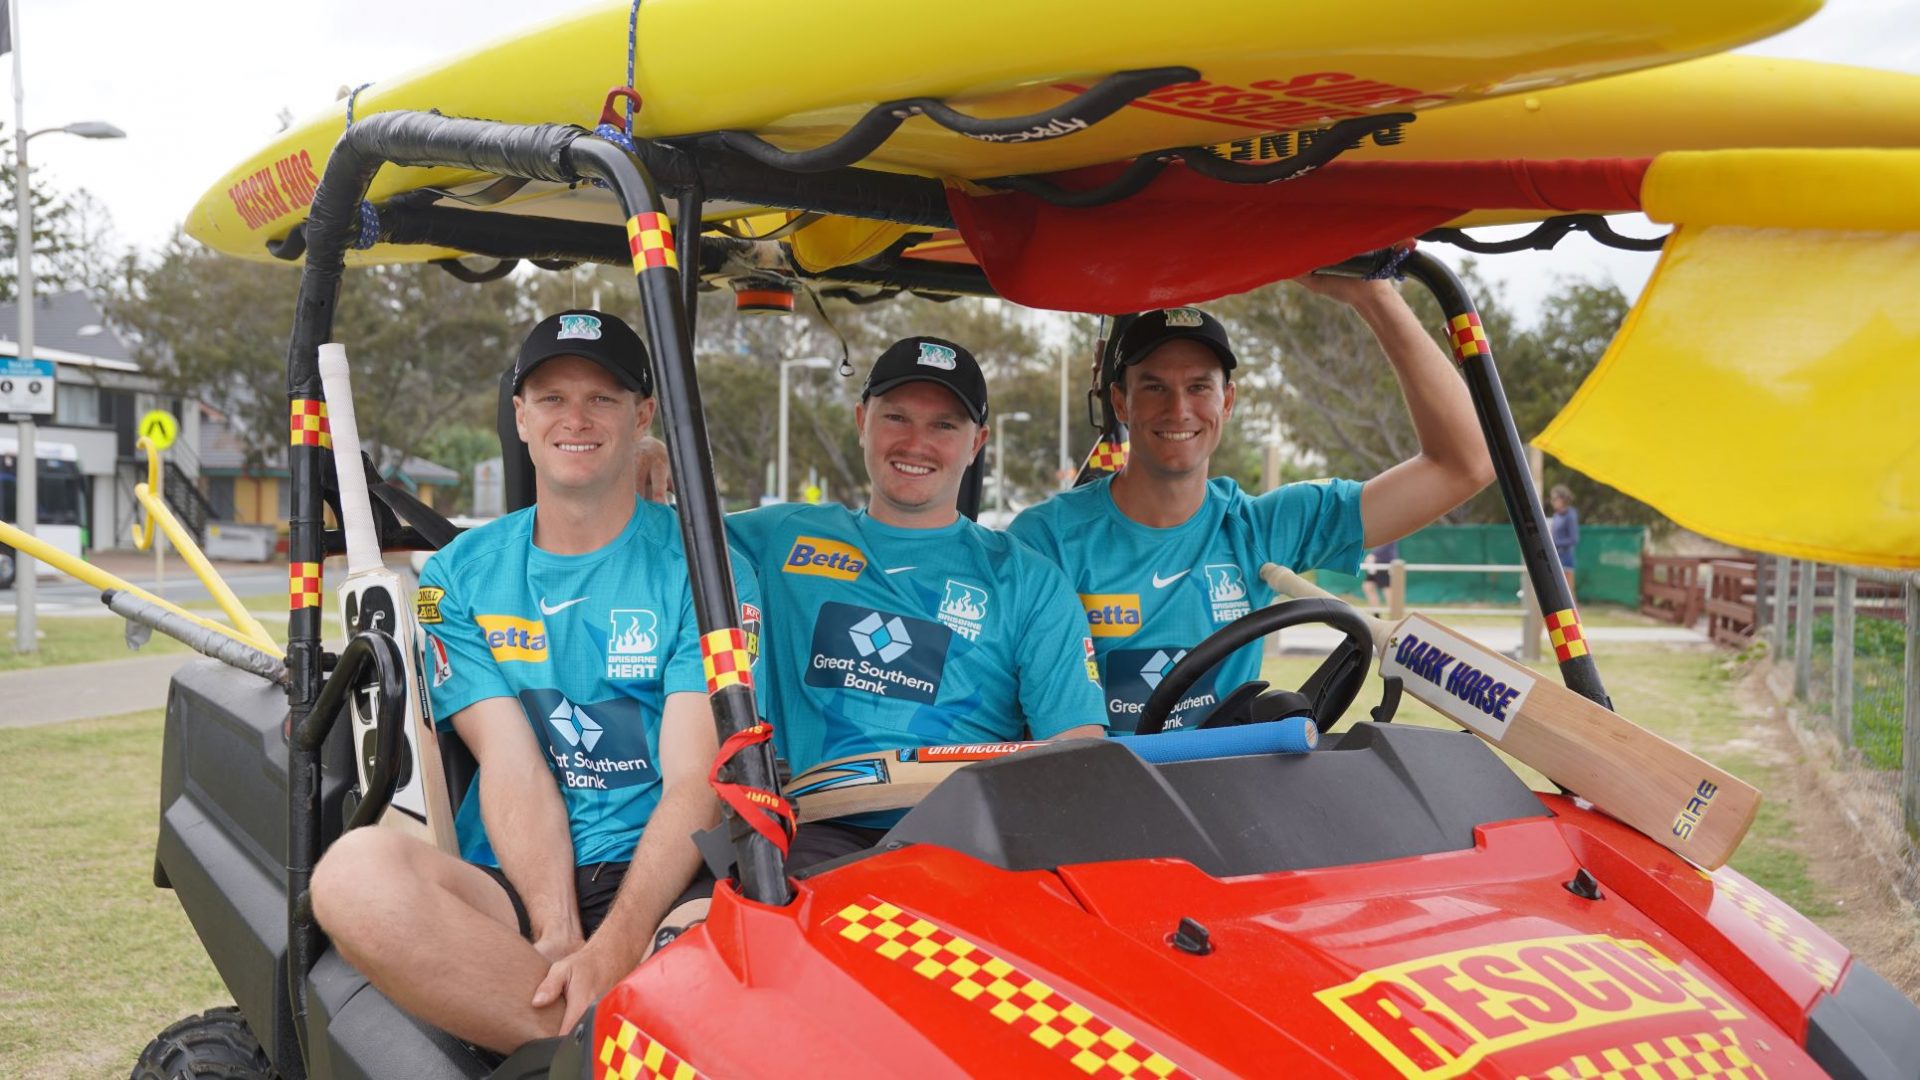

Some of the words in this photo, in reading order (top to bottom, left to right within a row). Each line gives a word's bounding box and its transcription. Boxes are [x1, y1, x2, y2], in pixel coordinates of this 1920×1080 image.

[228, 167, 291, 230] RESCUE
[788, 544, 865, 574] Betta
[419, 606, 438, 618] AGE
[745, 606, 760, 620] KFC
[1086, 605, 1140, 625] etta
[481, 626, 547, 651] etta
[943, 621, 981, 642] EAT
[608, 655, 657, 663] BRISBANE
[607, 664, 657, 678] HEAT
[813, 653, 855, 671] Great
[857, 660, 935, 694] Southern
[1395, 633, 1457, 687] DARK
[1445, 661, 1521, 723] HORSE
[843, 672, 888, 696] Bank
[1170, 693, 1216, 714] outhern
[1162, 714, 1184, 730] ank
[574, 751, 648, 773] Southern
[566, 771, 608, 789] Bank
[1672, 779, 1718, 840] SIRE
[1340, 940, 1728, 1073] RESCUE
